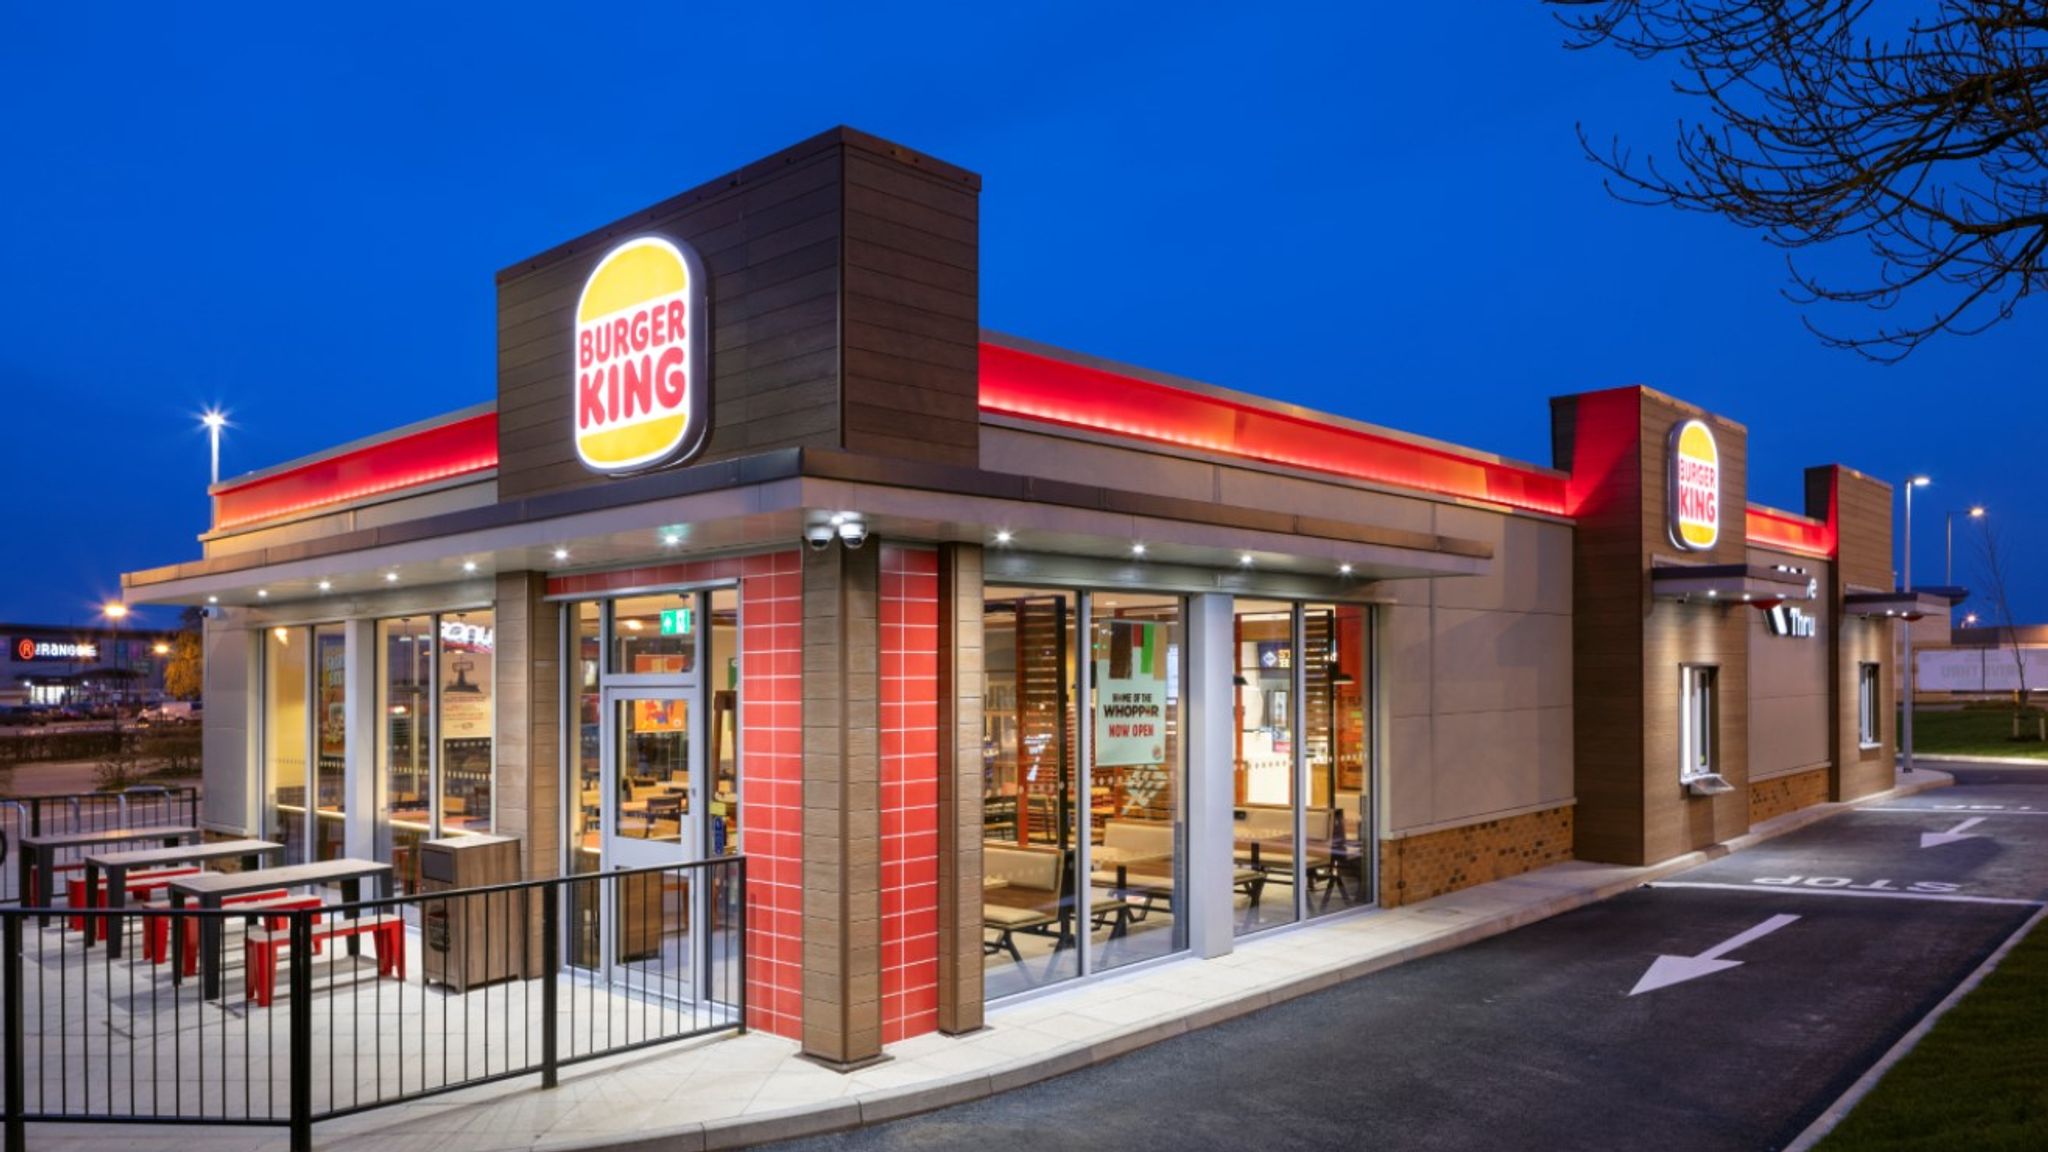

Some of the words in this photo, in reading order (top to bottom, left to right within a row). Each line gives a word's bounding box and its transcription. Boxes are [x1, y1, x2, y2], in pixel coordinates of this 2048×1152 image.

[579, 299, 686, 370] BURGER
[578, 346, 687, 431] KING
[1680, 458, 1716, 489] BURGER
[1680, 484, 1716, 524] KING
[1108, 723, 1130, 738] NOW
[1132, 723, 1154, 737] OPEN
[1752, 874, 1963, 894] STOP
